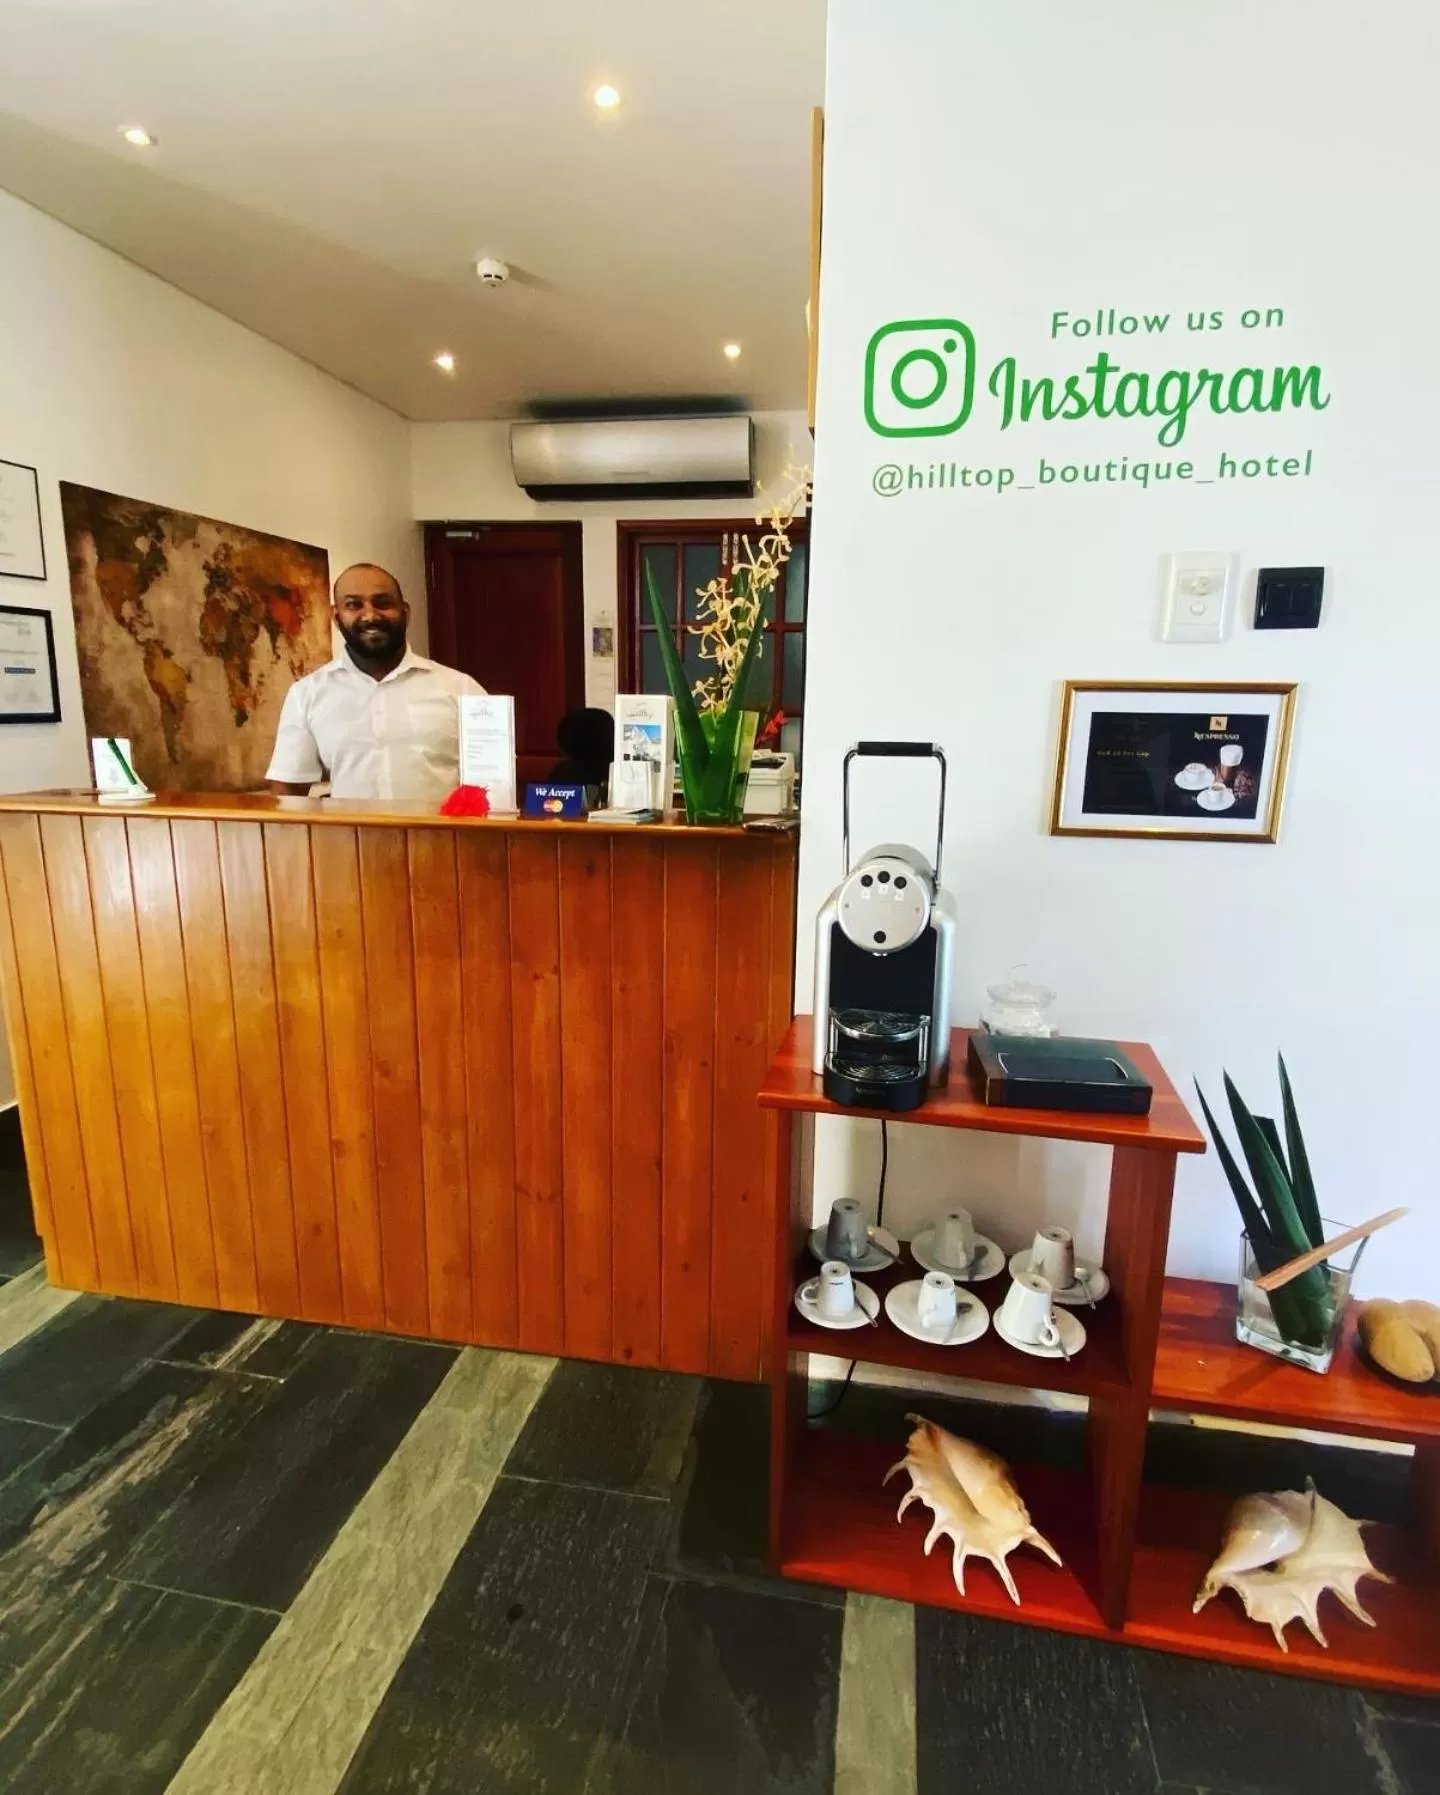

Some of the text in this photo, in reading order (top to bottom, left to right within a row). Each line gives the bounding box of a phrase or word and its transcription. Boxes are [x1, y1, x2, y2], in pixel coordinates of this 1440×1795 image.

[1050, 307, 1286, 338] Follow us on
[988, 351, 1331, 448] Instagram
[872, 449, 1313, 498] @hilltop_boutique_hotel
[535, 787, 576, 800] We Accept
